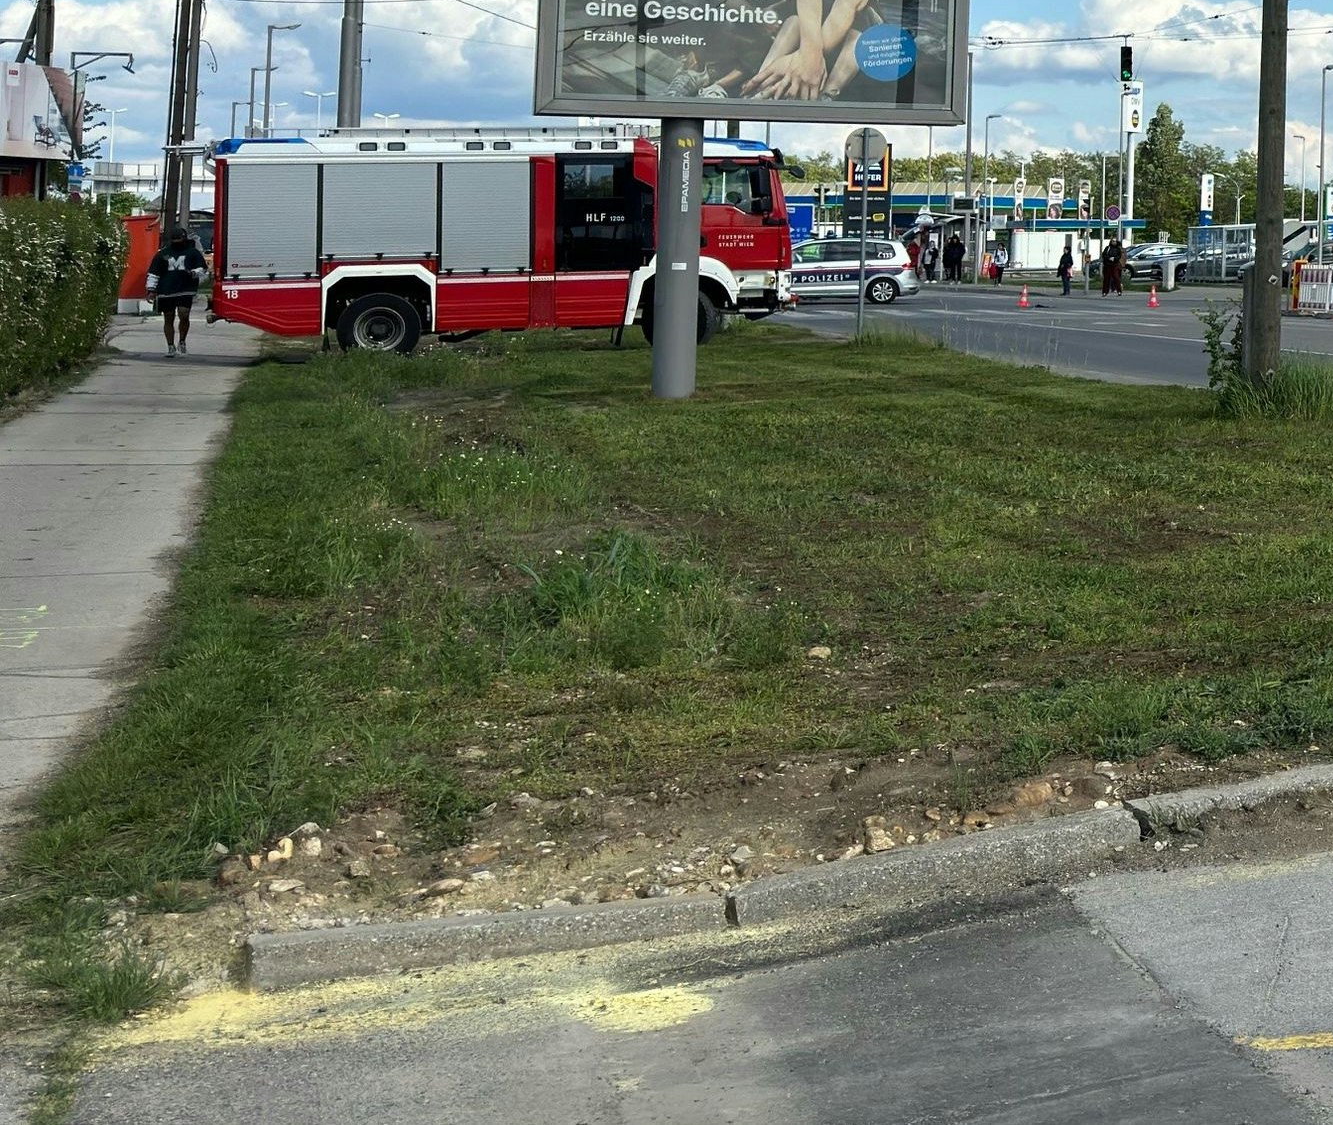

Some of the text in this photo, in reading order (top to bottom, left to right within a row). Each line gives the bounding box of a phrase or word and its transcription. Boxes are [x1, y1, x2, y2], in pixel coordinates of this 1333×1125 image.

[643, 0, 784, 25] Geschichte.
[583, 30, 707, 46] Erzähle sie weiter.
[868, 43, 903, 53] Sanieren
[863, 56, 913, 68] Förderungen
[585, 212, 607, 222] HLF
[167, 255, 186, 271] M
[801, 274, 844, 283] POLIZEI
[224, 289, 239, 300] 18
